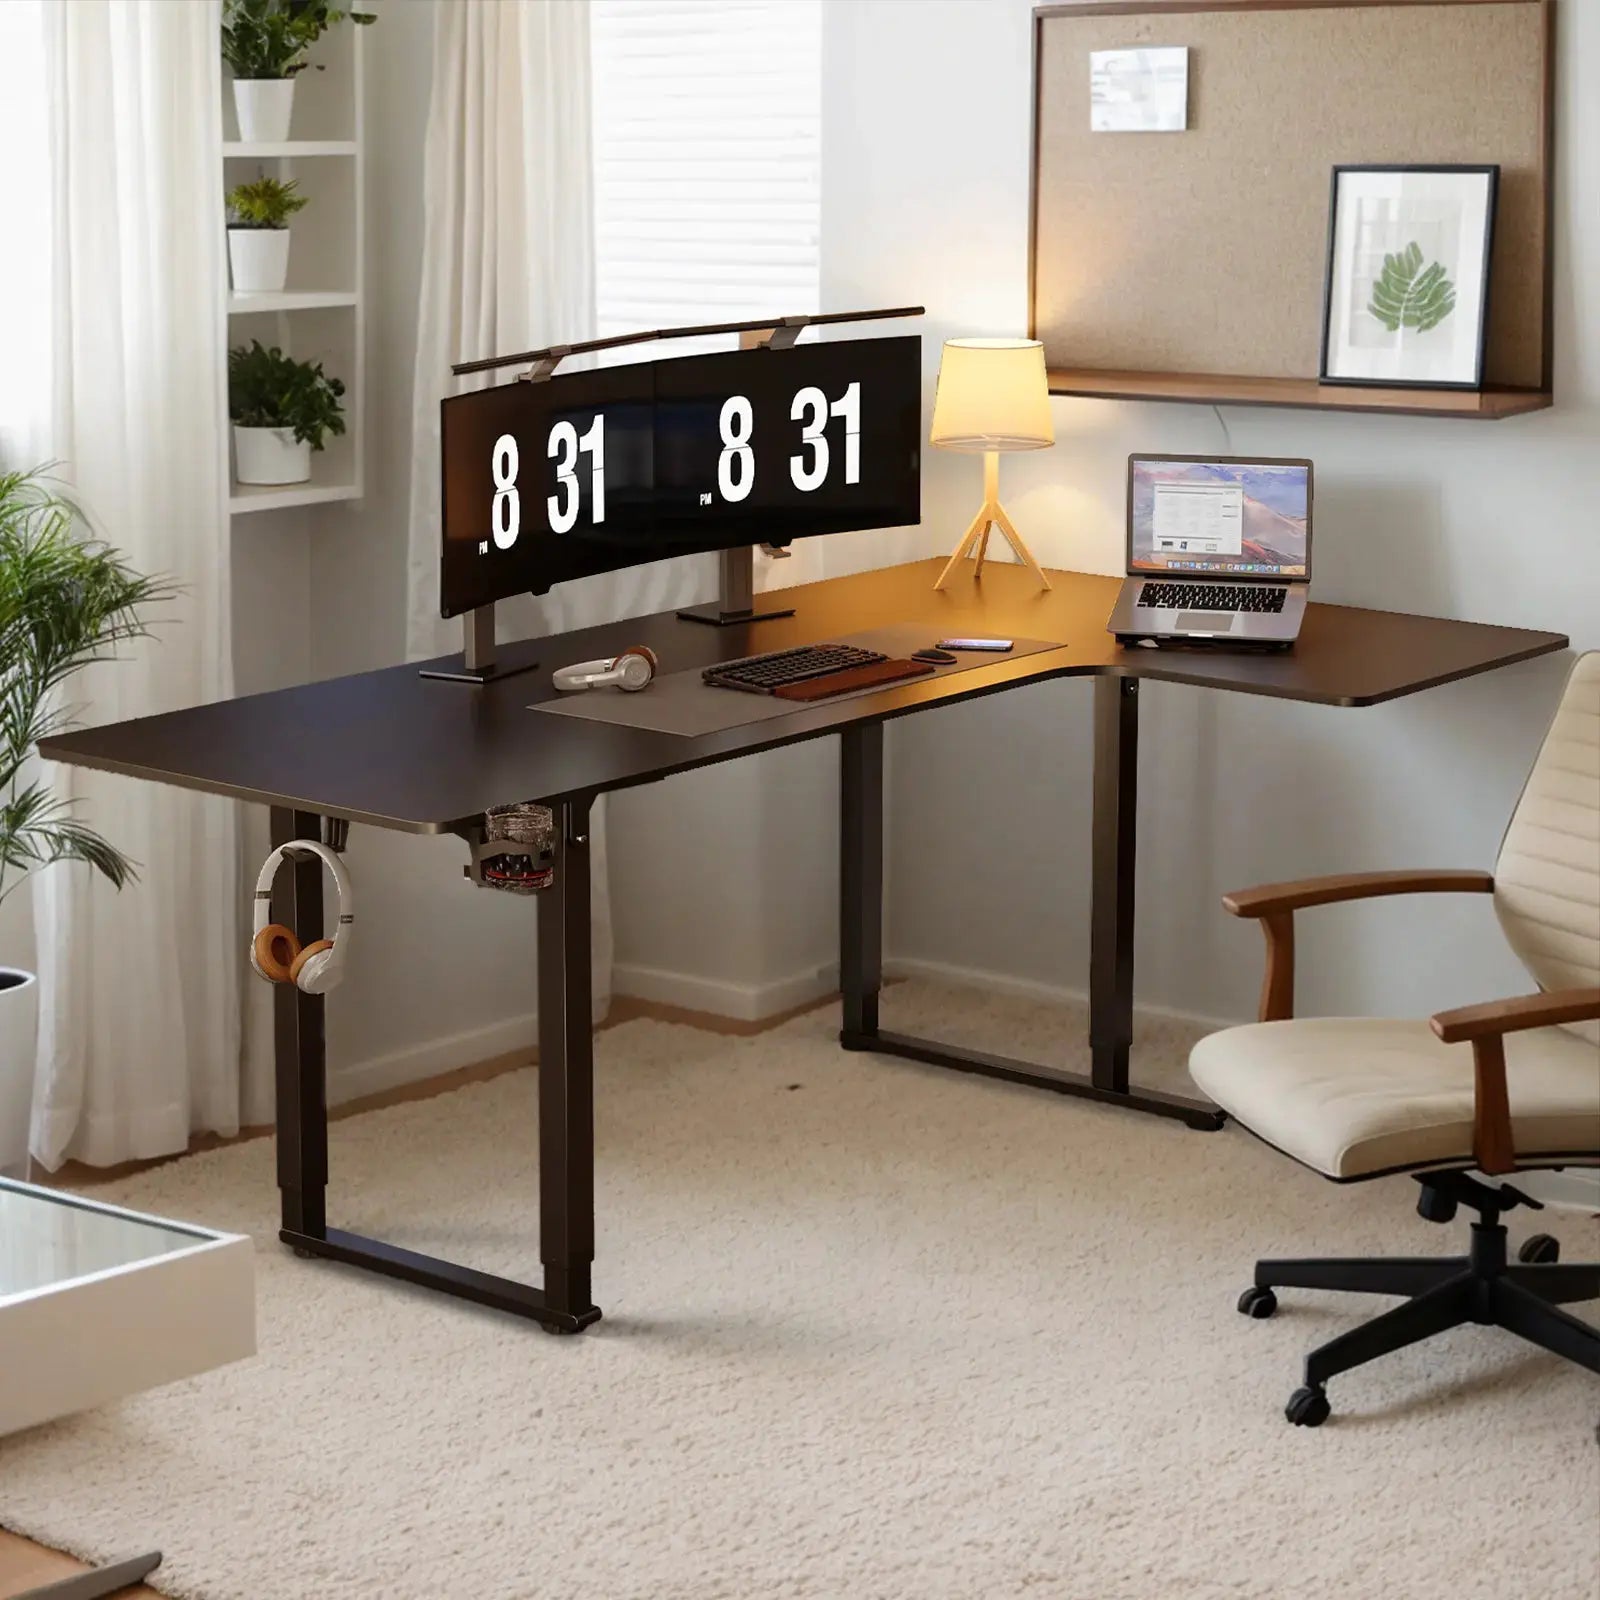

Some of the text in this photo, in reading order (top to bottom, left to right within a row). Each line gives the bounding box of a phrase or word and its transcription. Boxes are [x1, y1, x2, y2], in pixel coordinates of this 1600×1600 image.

[491, 434, 520, 549] 8
[547, 414, 605, 533] 31
[700, 382, 861, 506] PM 8 31
